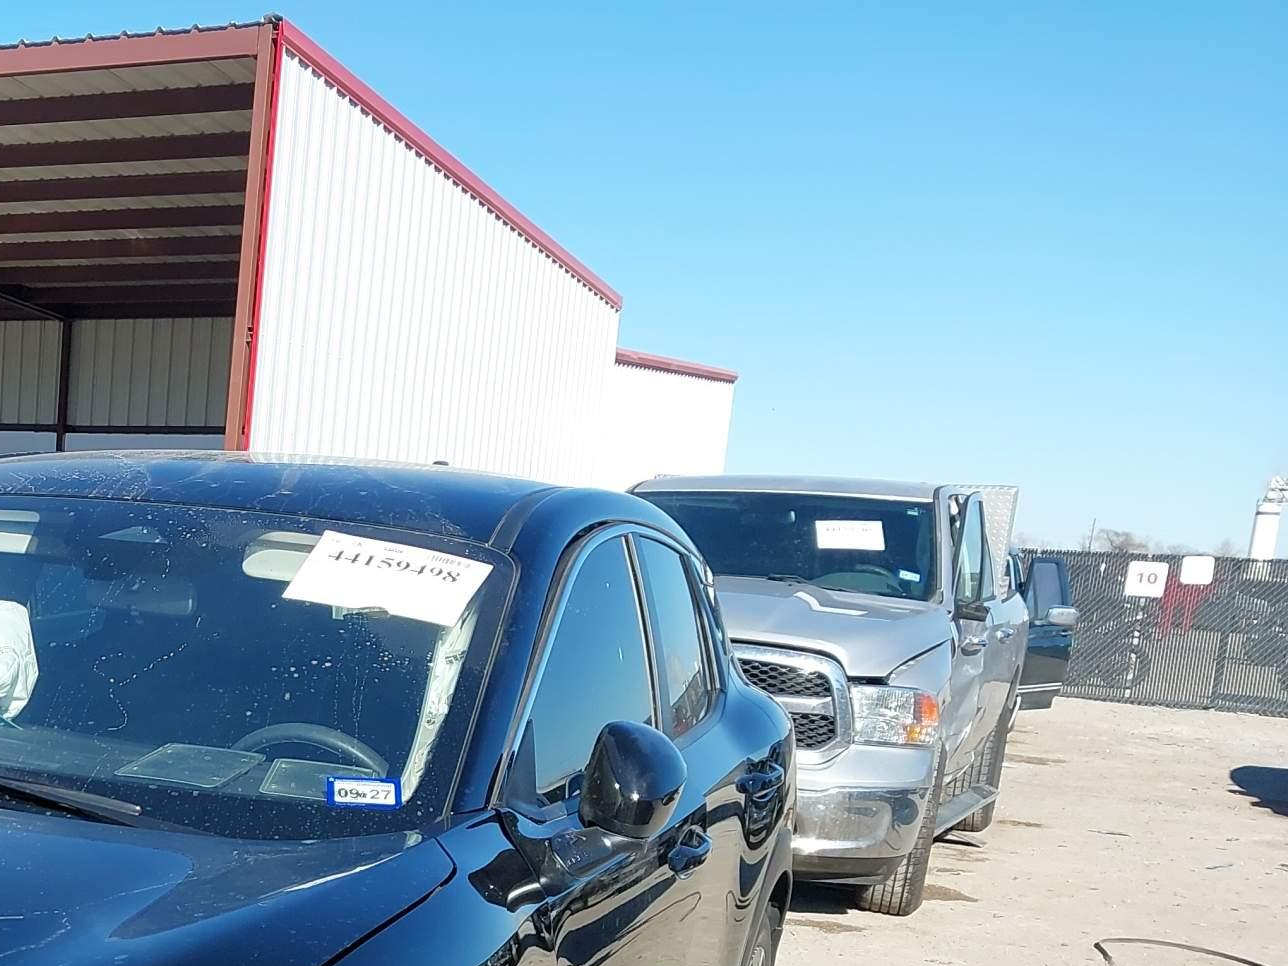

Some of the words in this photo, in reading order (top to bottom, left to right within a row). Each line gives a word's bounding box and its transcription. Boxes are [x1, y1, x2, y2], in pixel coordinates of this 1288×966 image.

[328, 548, 462, 583] 44159498
[1137, 572, 1158, 585] 10
[337, 788, 359, 799] 09
[369, 789, 392, 800] 27
